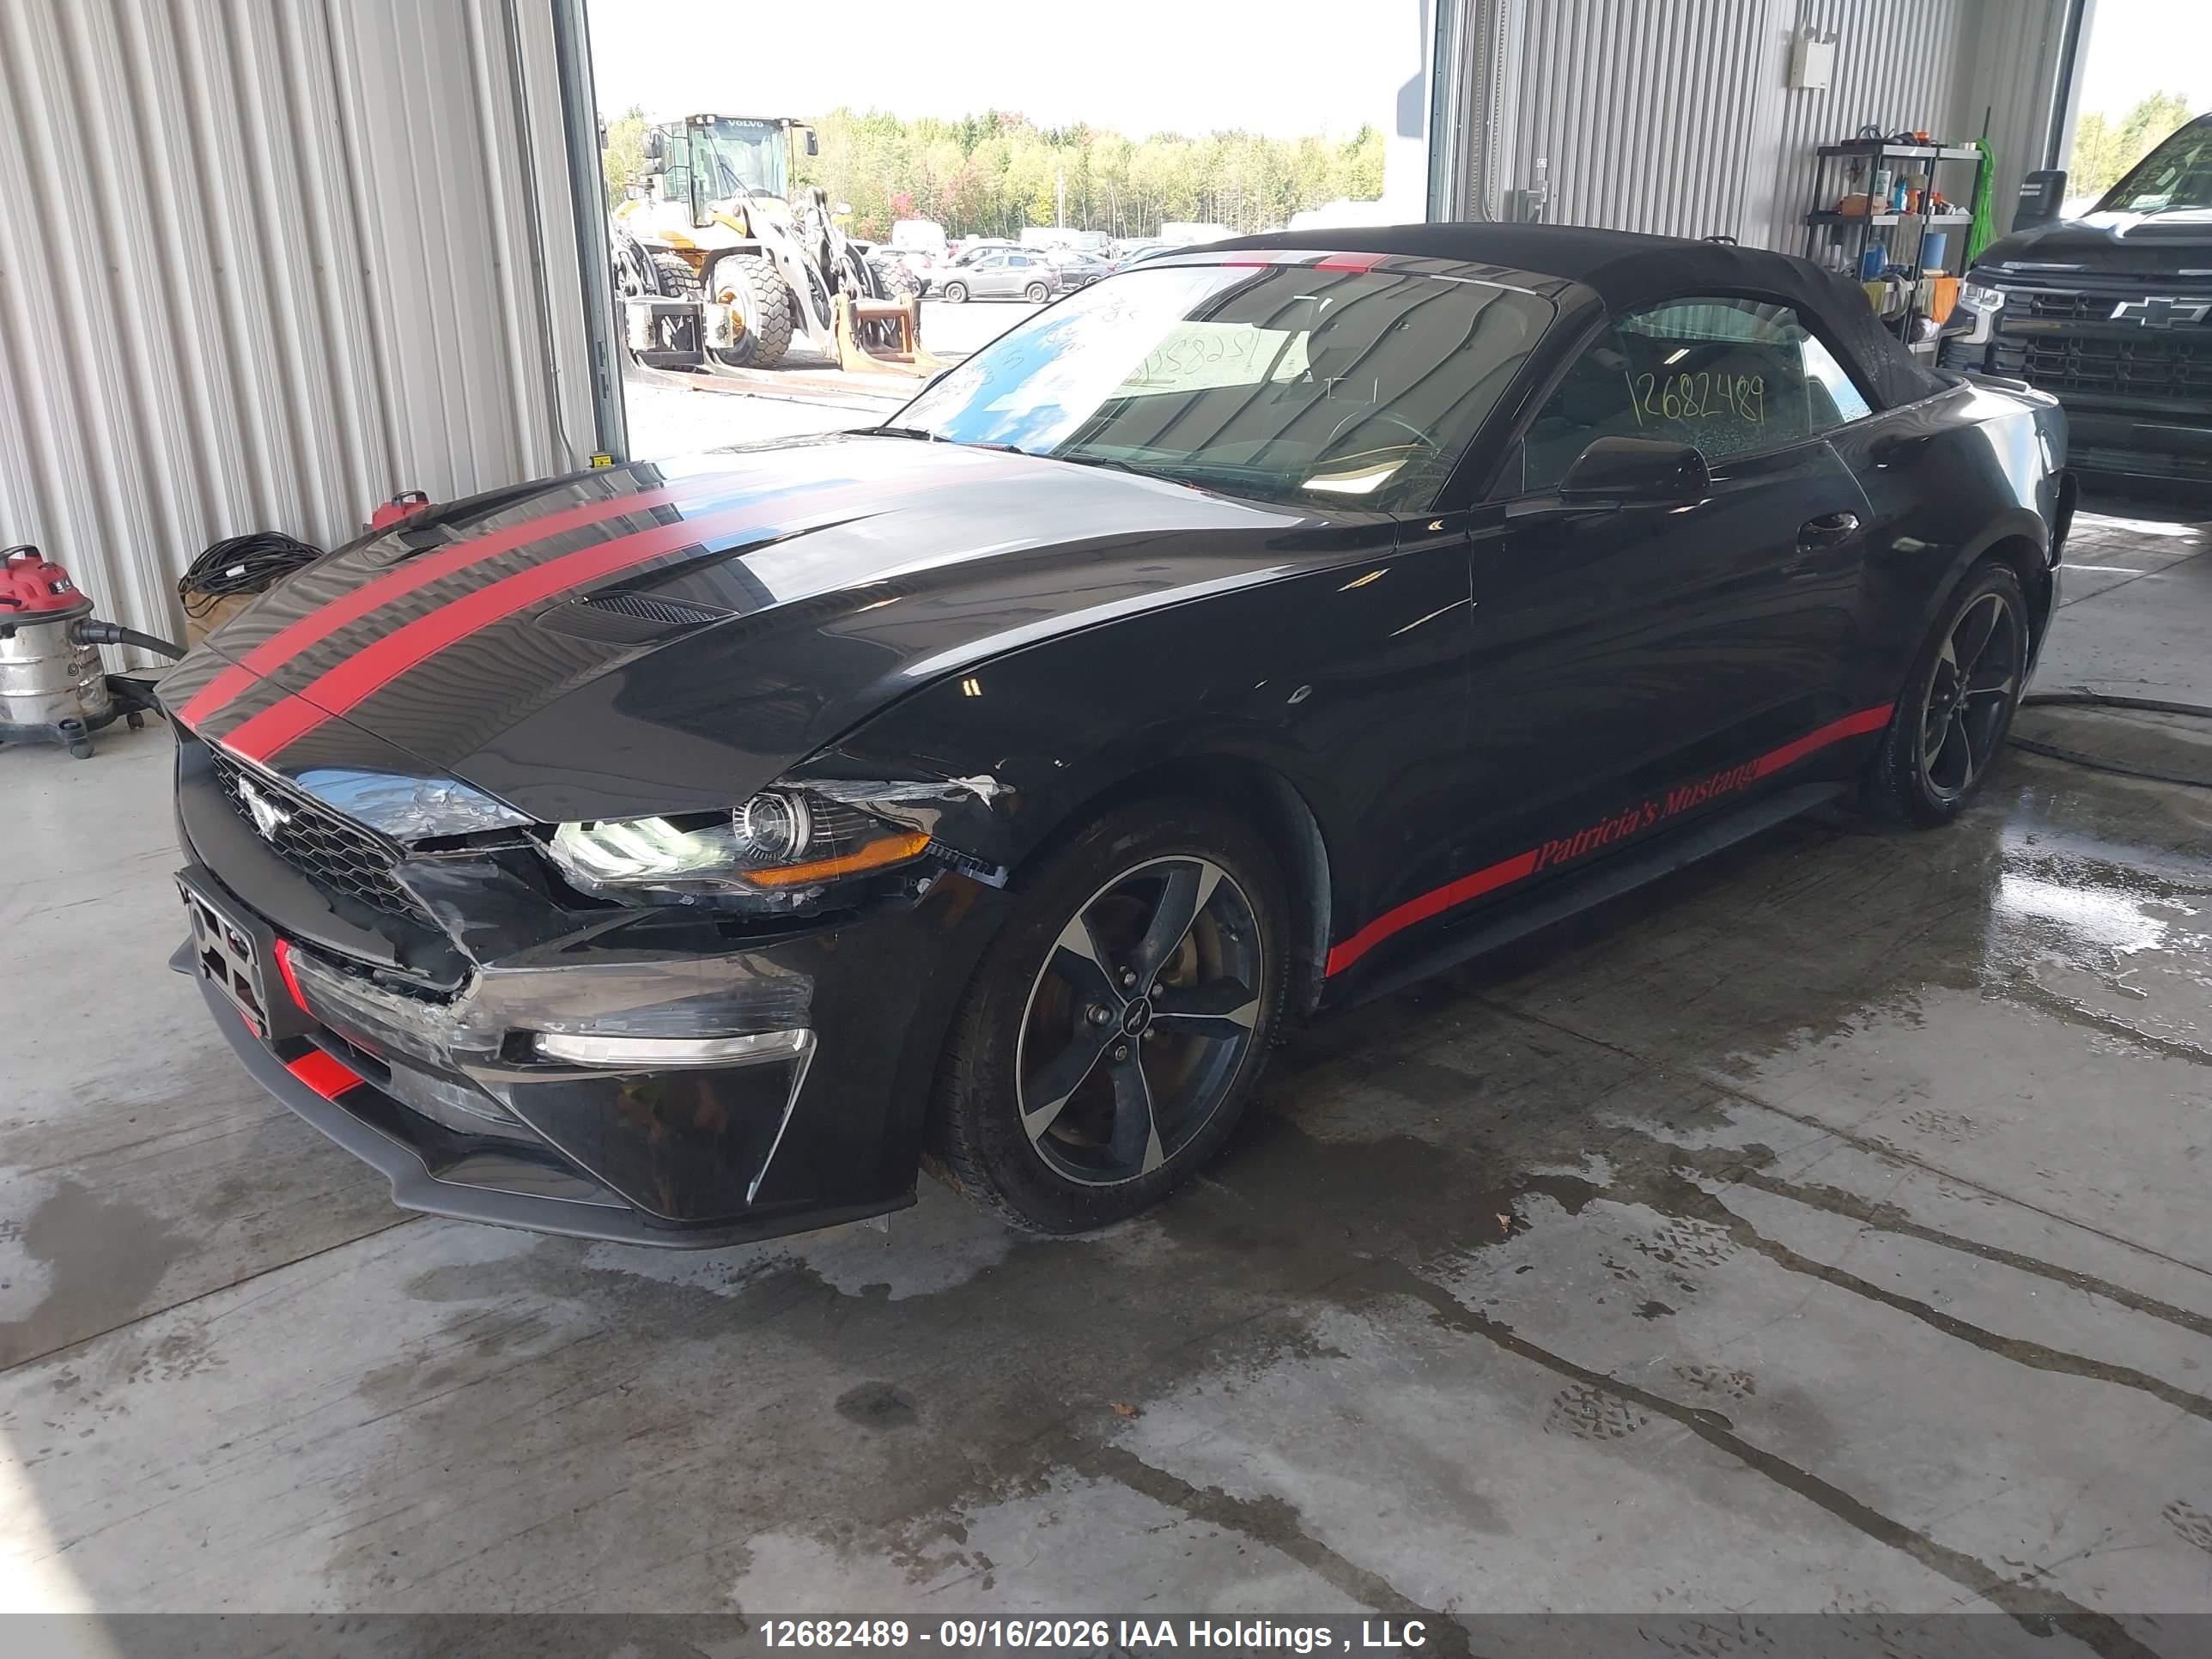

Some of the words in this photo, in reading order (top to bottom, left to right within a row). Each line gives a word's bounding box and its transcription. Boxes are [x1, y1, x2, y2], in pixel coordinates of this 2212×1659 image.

[727, 119, 764, 128] VOLVO
[1625, 370, 1765, 428] 12682489
[1534, 800, 1658, 873] Patricia's
[1661, 758, 1760, 818] Mustang
